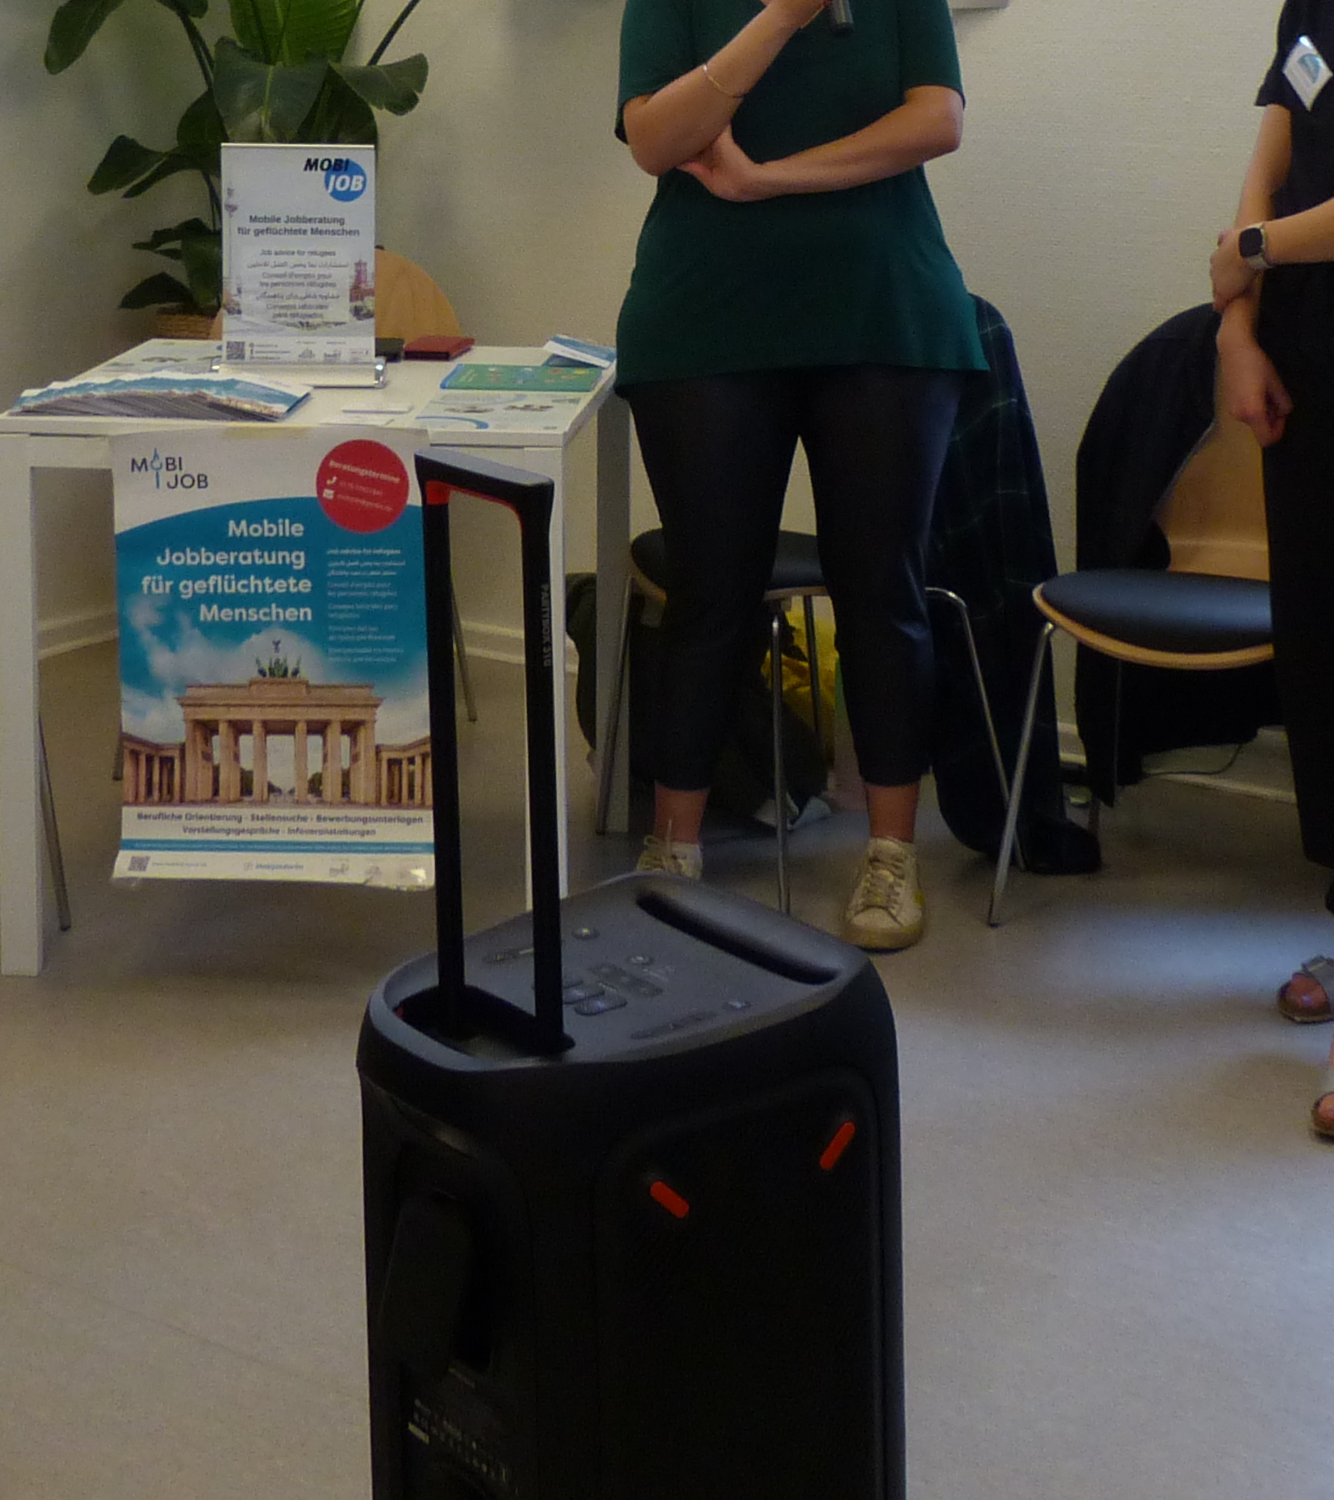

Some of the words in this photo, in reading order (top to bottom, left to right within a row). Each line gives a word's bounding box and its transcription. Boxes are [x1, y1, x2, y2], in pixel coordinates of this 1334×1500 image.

[303, 158, 349, 172] MOBI
[328, 174, 365, 193] JOB
[249, 214, 282, 224] Mobile
[284, 214, 346, 226] Jobberatung
[237, 226, 253, 236] für
[253, 226, 308, 237] geflüchtete
[310, 226, 361, 237] Menschen
[130, 455, 183, 473] MOBI
[166, 473, 210, 490] JOB
[228, 518, 305, 538] Mobile
[155, 547, 307, 570] Jobberatung
[141, 574, 174, 595] für
[178, 574, 313, 600] geflüchtete
[199, 603, 313, 622] Menschen
[136, 812, 183, 822] Berufliche
[185, 812, 244, 824] Orientierung
[250, 812, 309, 823] Stellensuche
[316, 813, 425, 826] Bewerbungsunterlagen
[182, 825, 281, 836] Vorstellungsgespräche
[287, 826, 377, 838] Infoveranstaltungen
